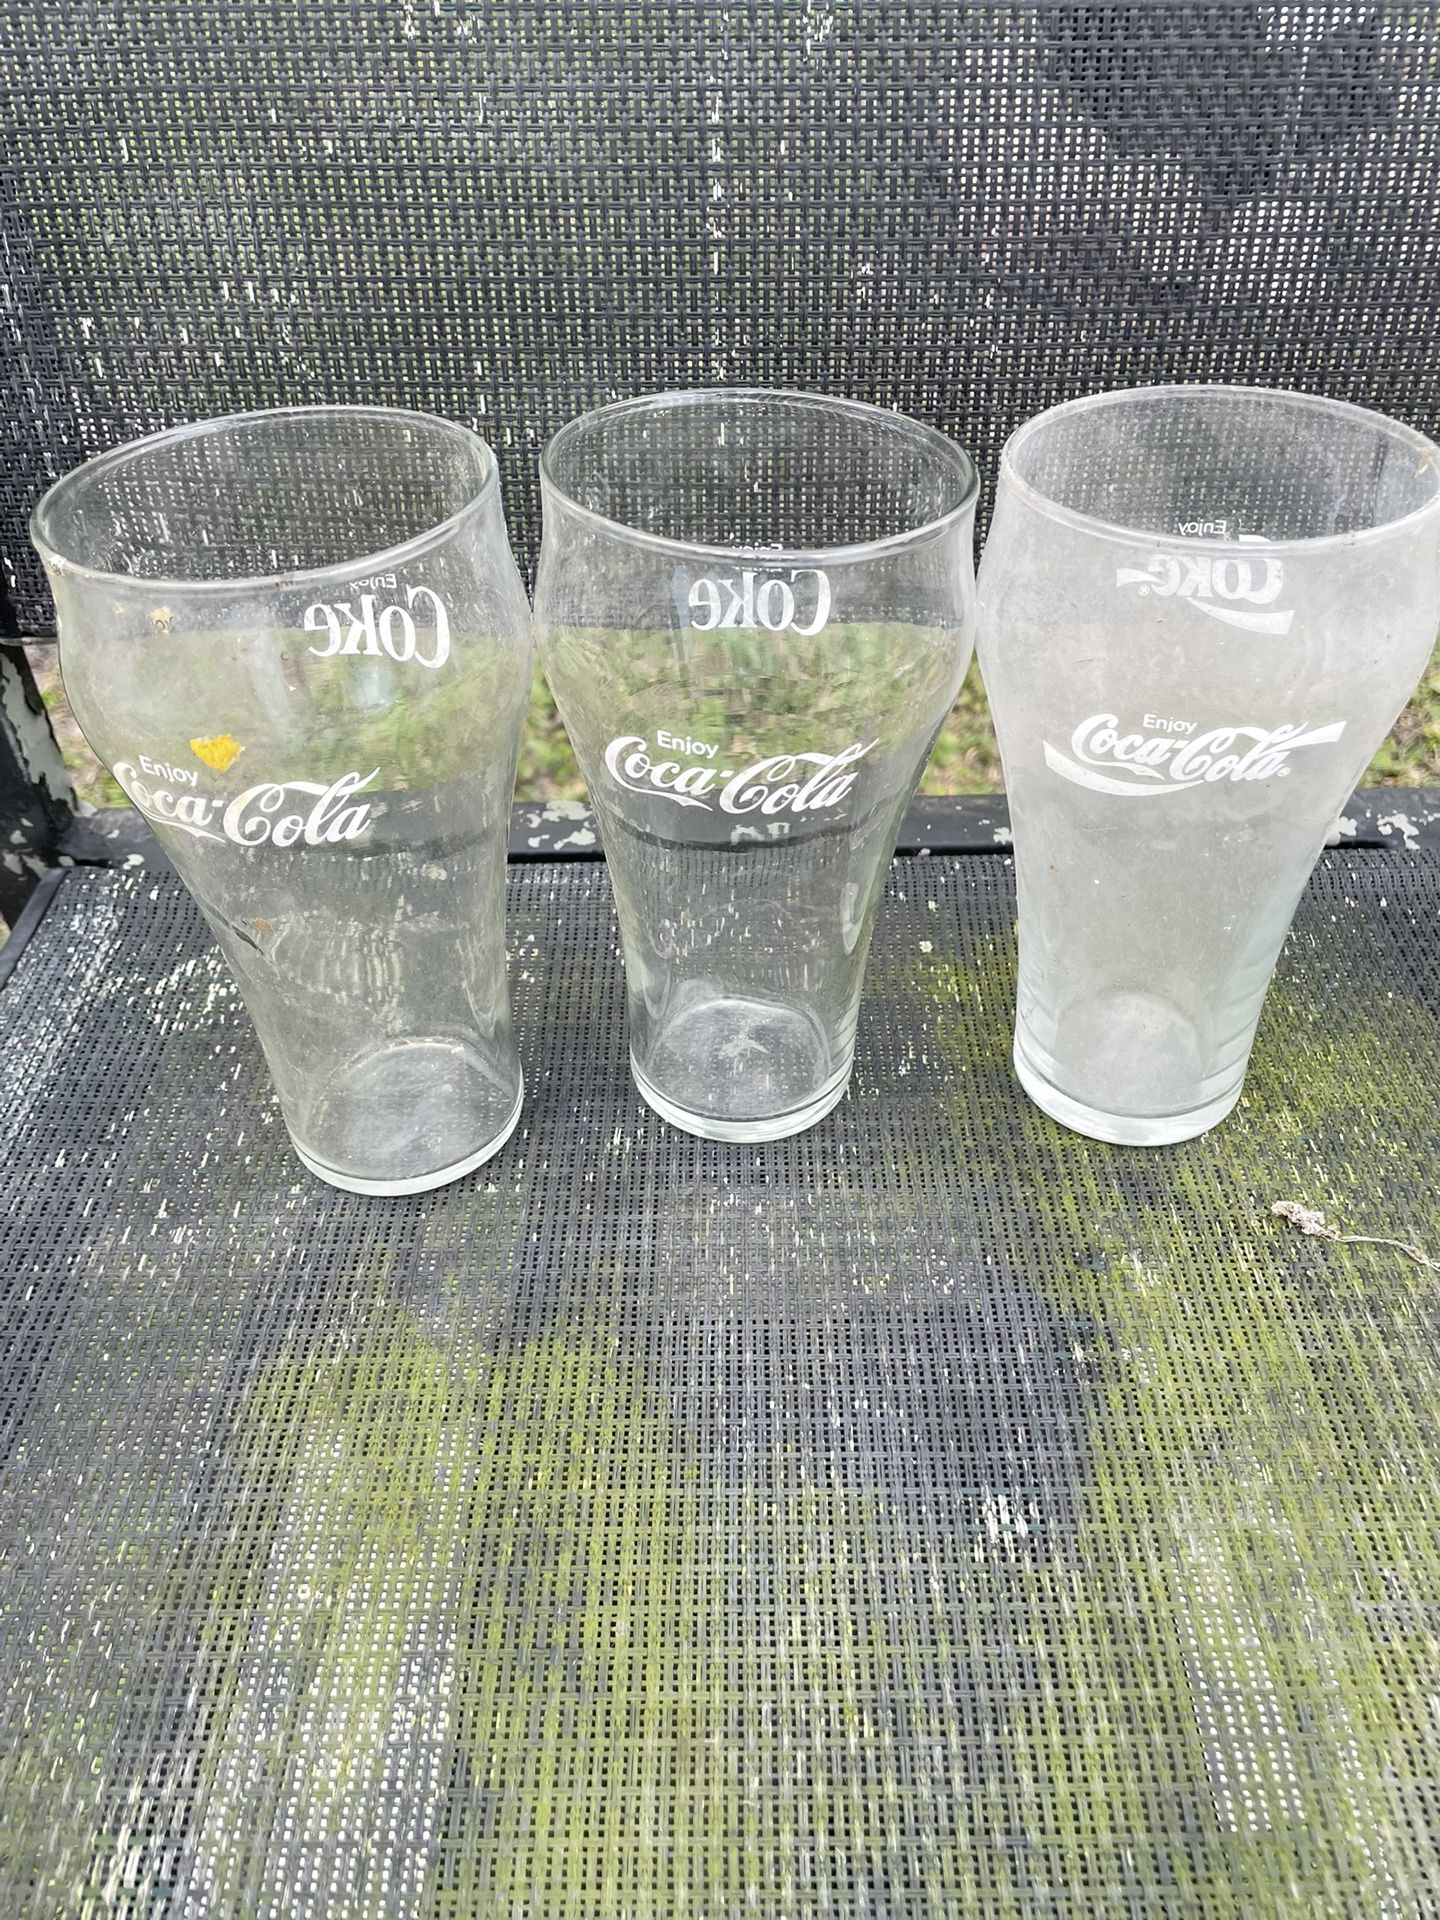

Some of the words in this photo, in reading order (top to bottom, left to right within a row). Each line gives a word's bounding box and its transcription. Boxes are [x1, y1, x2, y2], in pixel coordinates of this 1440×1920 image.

[1143, 713, 1198, 733] Enjoy
[656, 729, 719, 758] Enjoy
[138, 754, 198, 787] Enjoy
[604, 736, 880, 814] Coca-Cola
[112, 761, 381, 847] Coca-Cola
